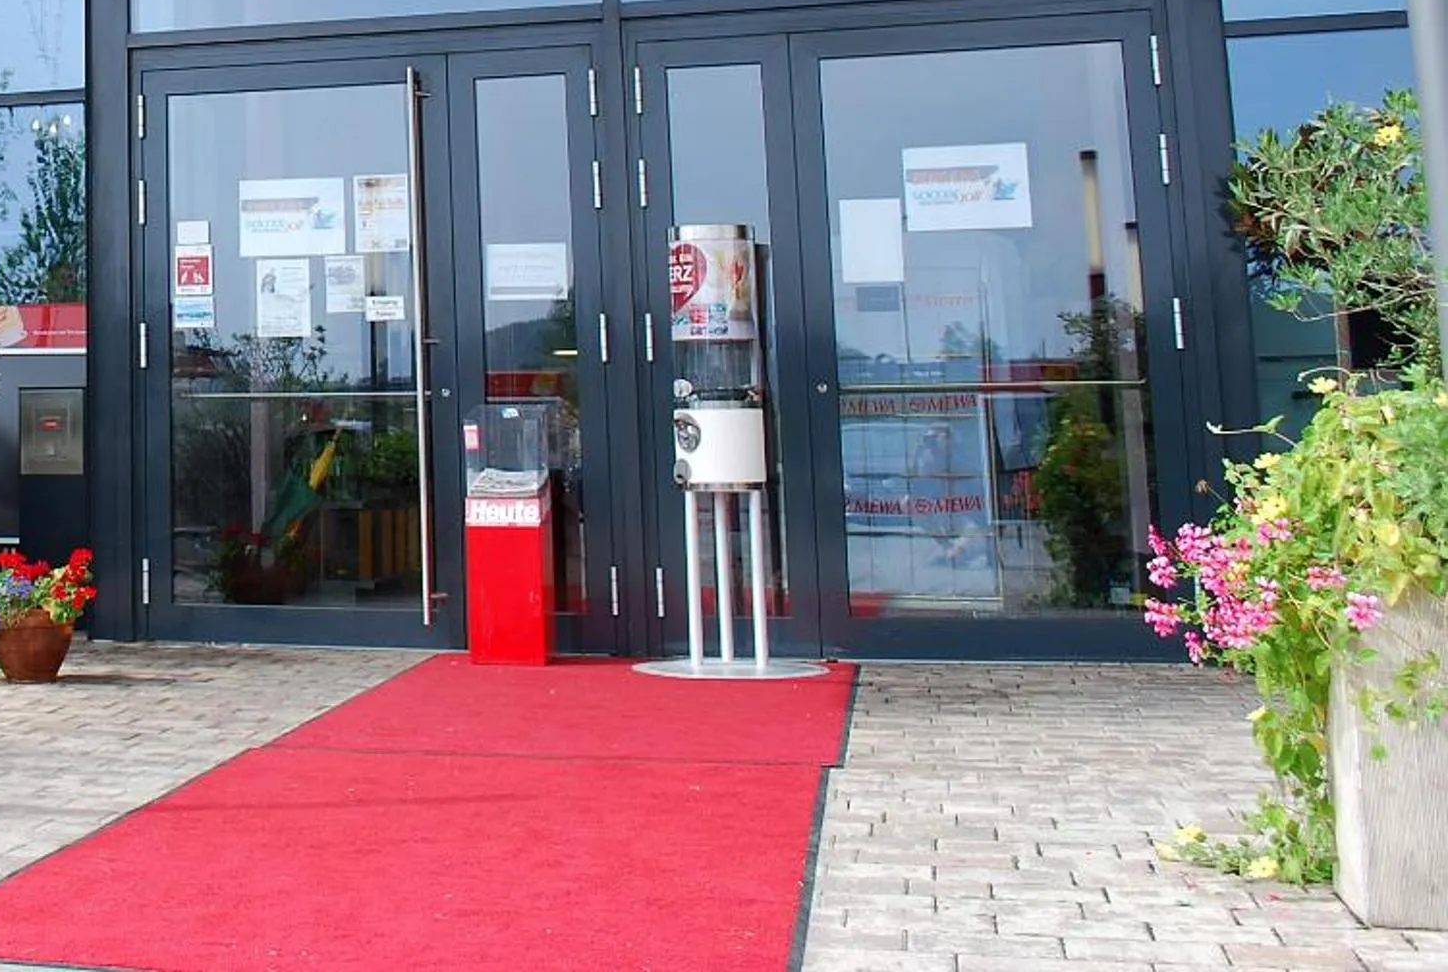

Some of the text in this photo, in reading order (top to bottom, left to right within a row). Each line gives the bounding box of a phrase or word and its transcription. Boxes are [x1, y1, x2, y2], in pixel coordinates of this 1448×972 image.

[928, 394, 978, 412] MEWA
[469, 501, 541, 525] Heute
[854, 495, 982, 515] MEWA MEWA
